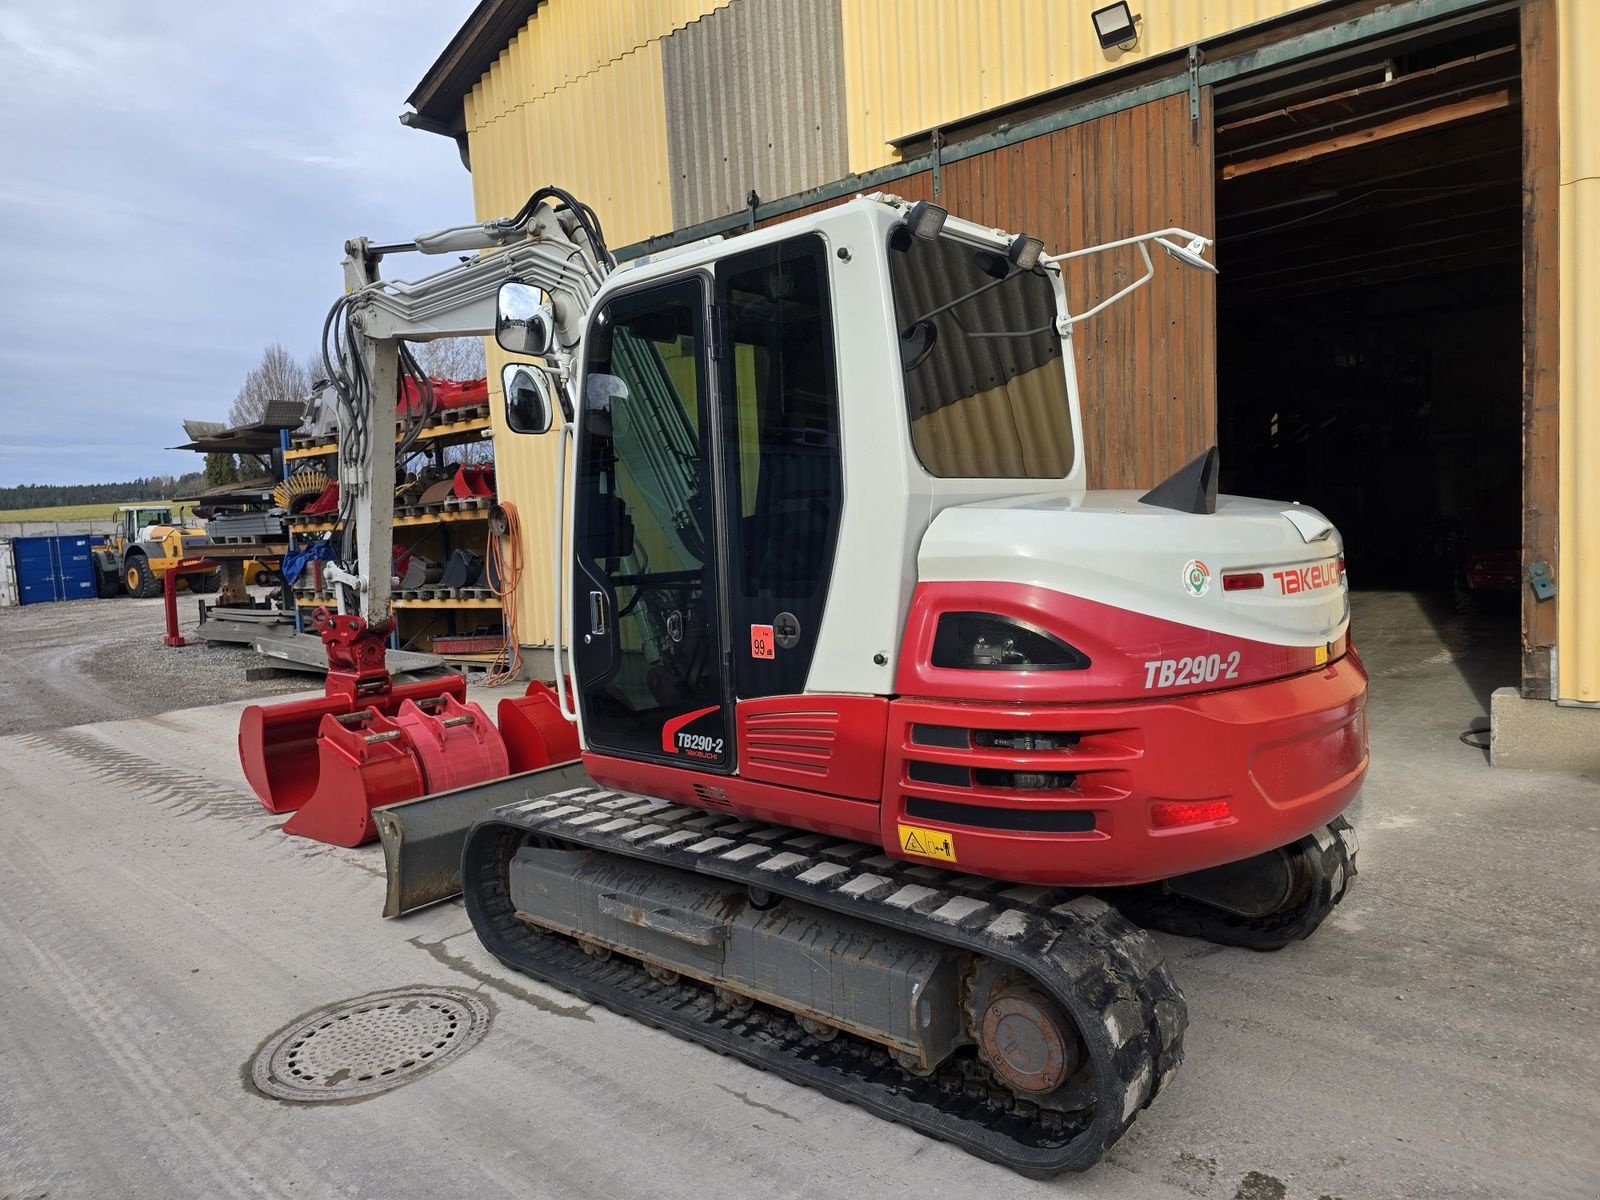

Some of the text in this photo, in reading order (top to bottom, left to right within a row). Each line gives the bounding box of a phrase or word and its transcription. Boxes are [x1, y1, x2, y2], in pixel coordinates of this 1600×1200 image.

[754, 639, 765, 656] 99
[1144, 651, 1241, 689] TB290-2
[678, 732, 724, 754] TB290-2
